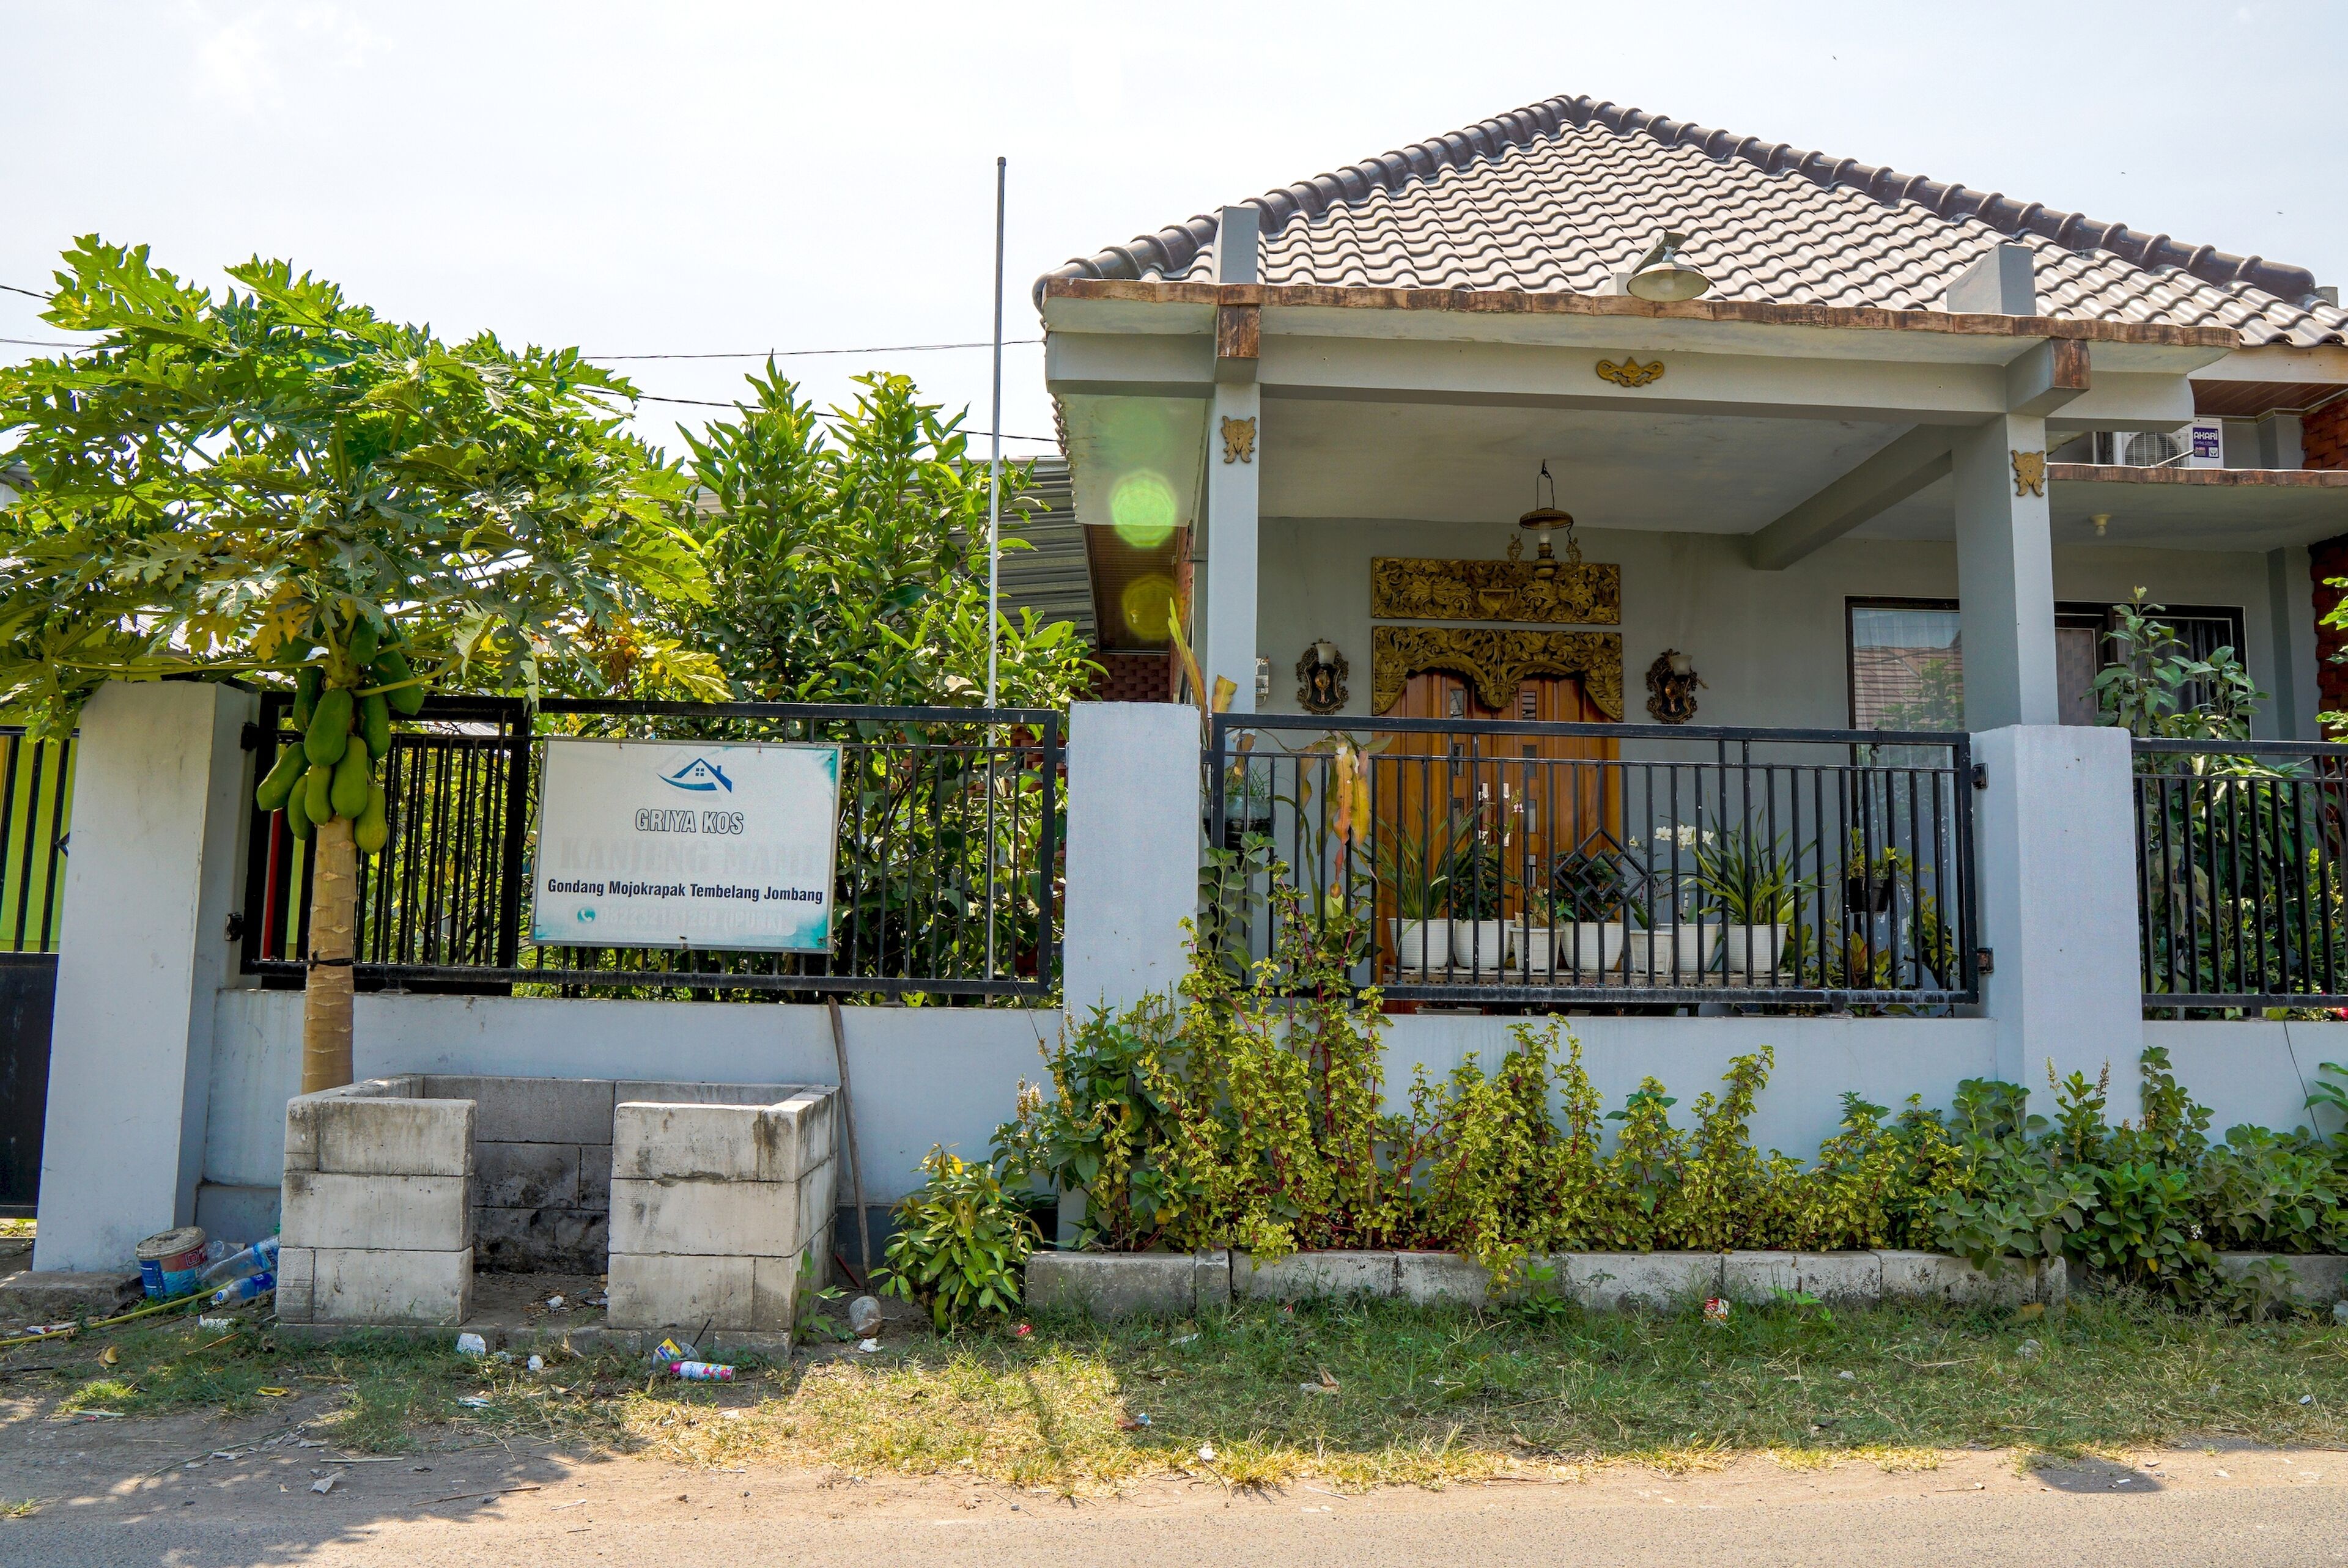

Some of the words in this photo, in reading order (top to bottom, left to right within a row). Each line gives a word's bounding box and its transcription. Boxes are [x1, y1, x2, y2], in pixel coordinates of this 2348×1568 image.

[2194, 430, 2218, 440] AKARI
[635, 808, 696, 833] GRIYA
[702, 811, 744, 834] KOS
[548, 878, 604, 896] Gondang
[609, 881, 685, 899] Mojokrapak
[690, 884, 759, 902] Tembelang
[764, 886, 823, 905] Jombang
